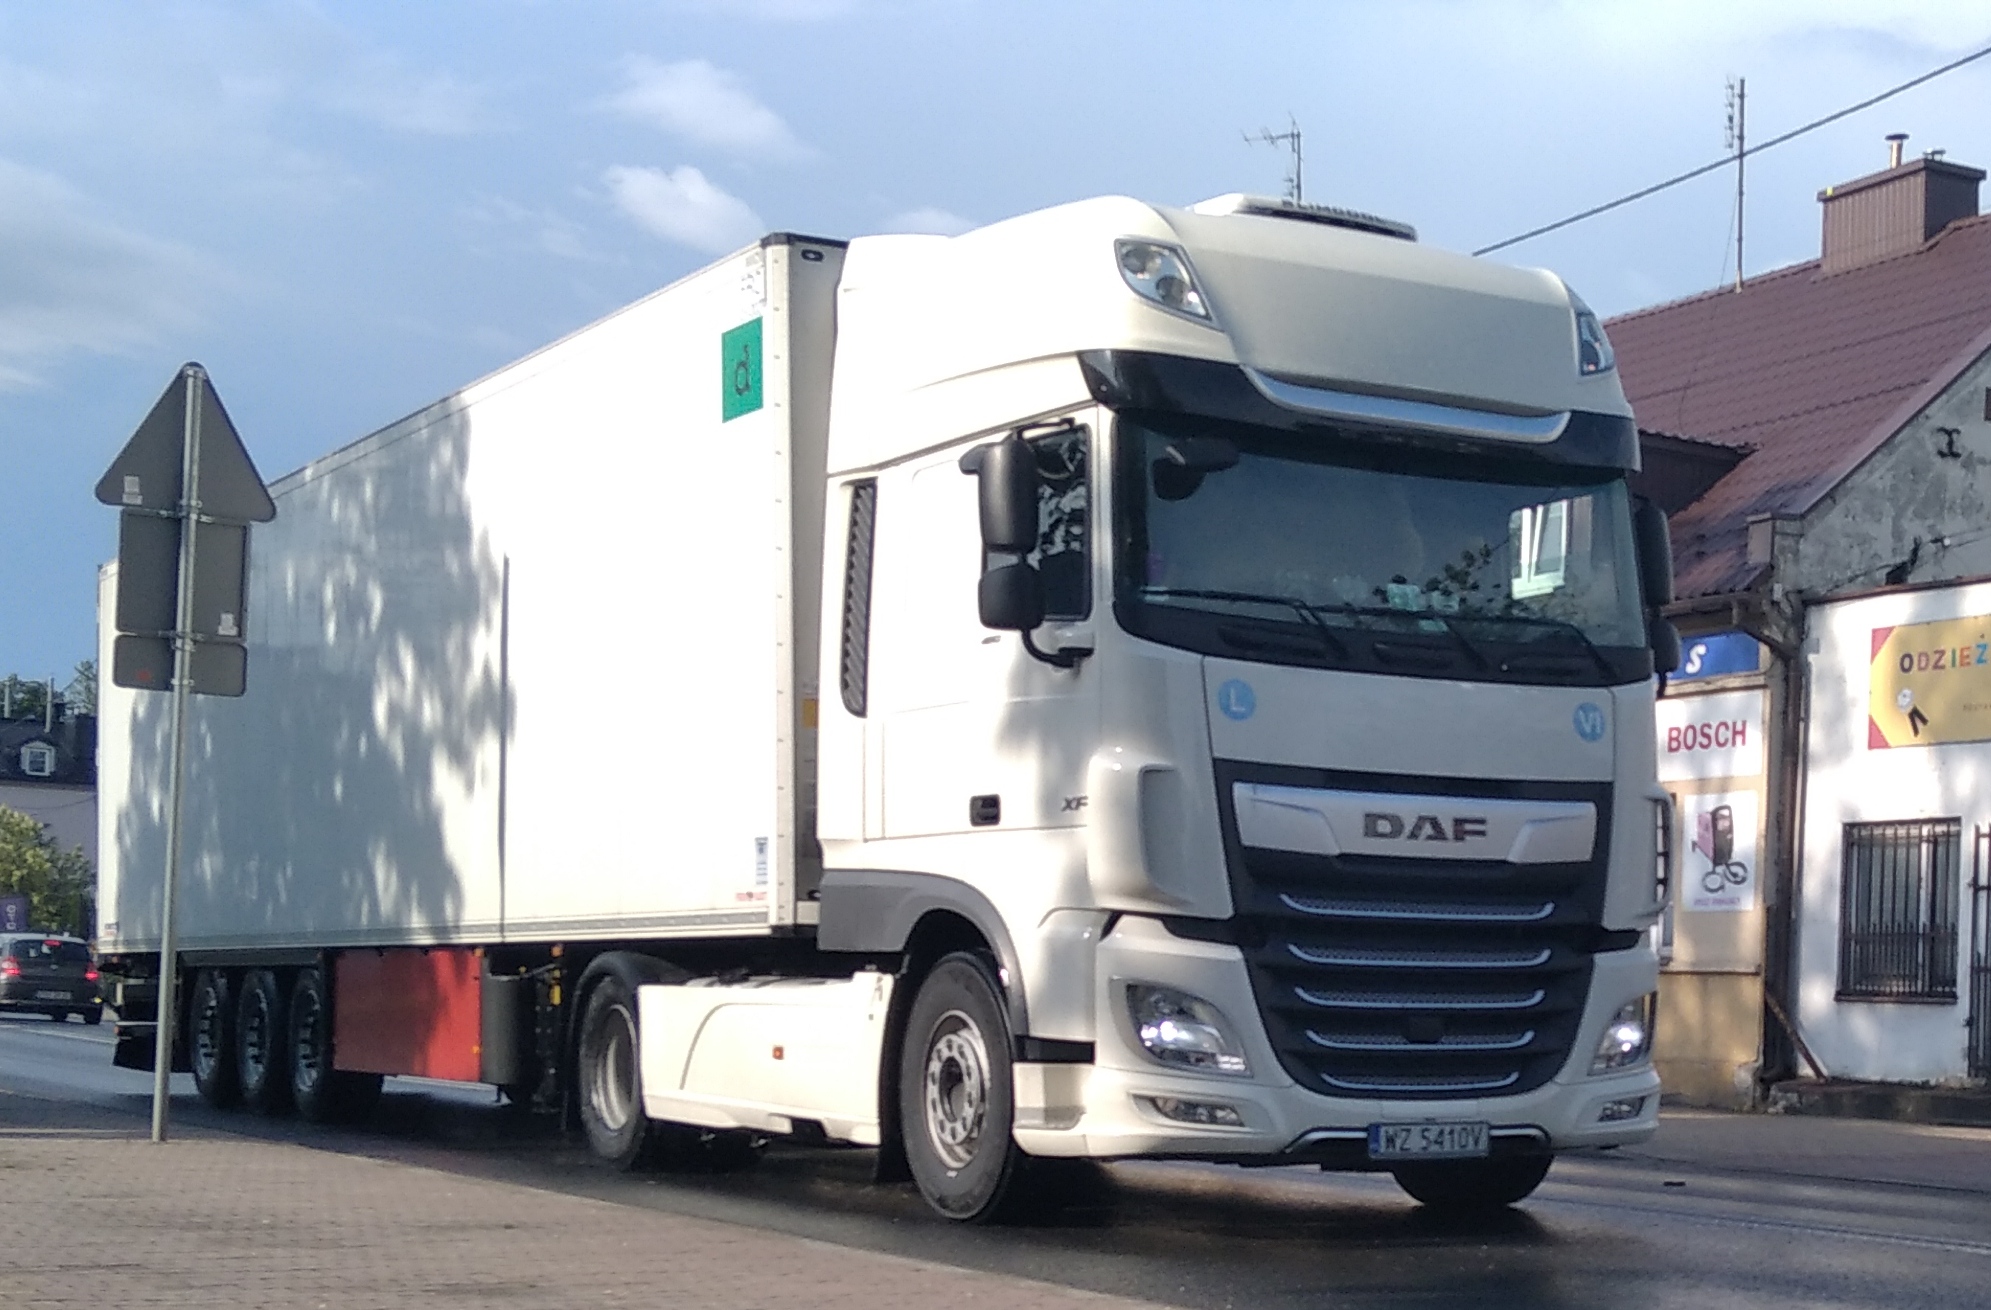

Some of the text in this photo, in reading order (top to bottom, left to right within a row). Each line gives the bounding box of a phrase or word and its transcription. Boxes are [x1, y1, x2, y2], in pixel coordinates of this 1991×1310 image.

[1228, 687, 1248, 711] L
[1668, 720, 1748, 753] BOSCH
[1061, 795, 1089, 812] XF
[1364, 813, 1487, 842] DAF
